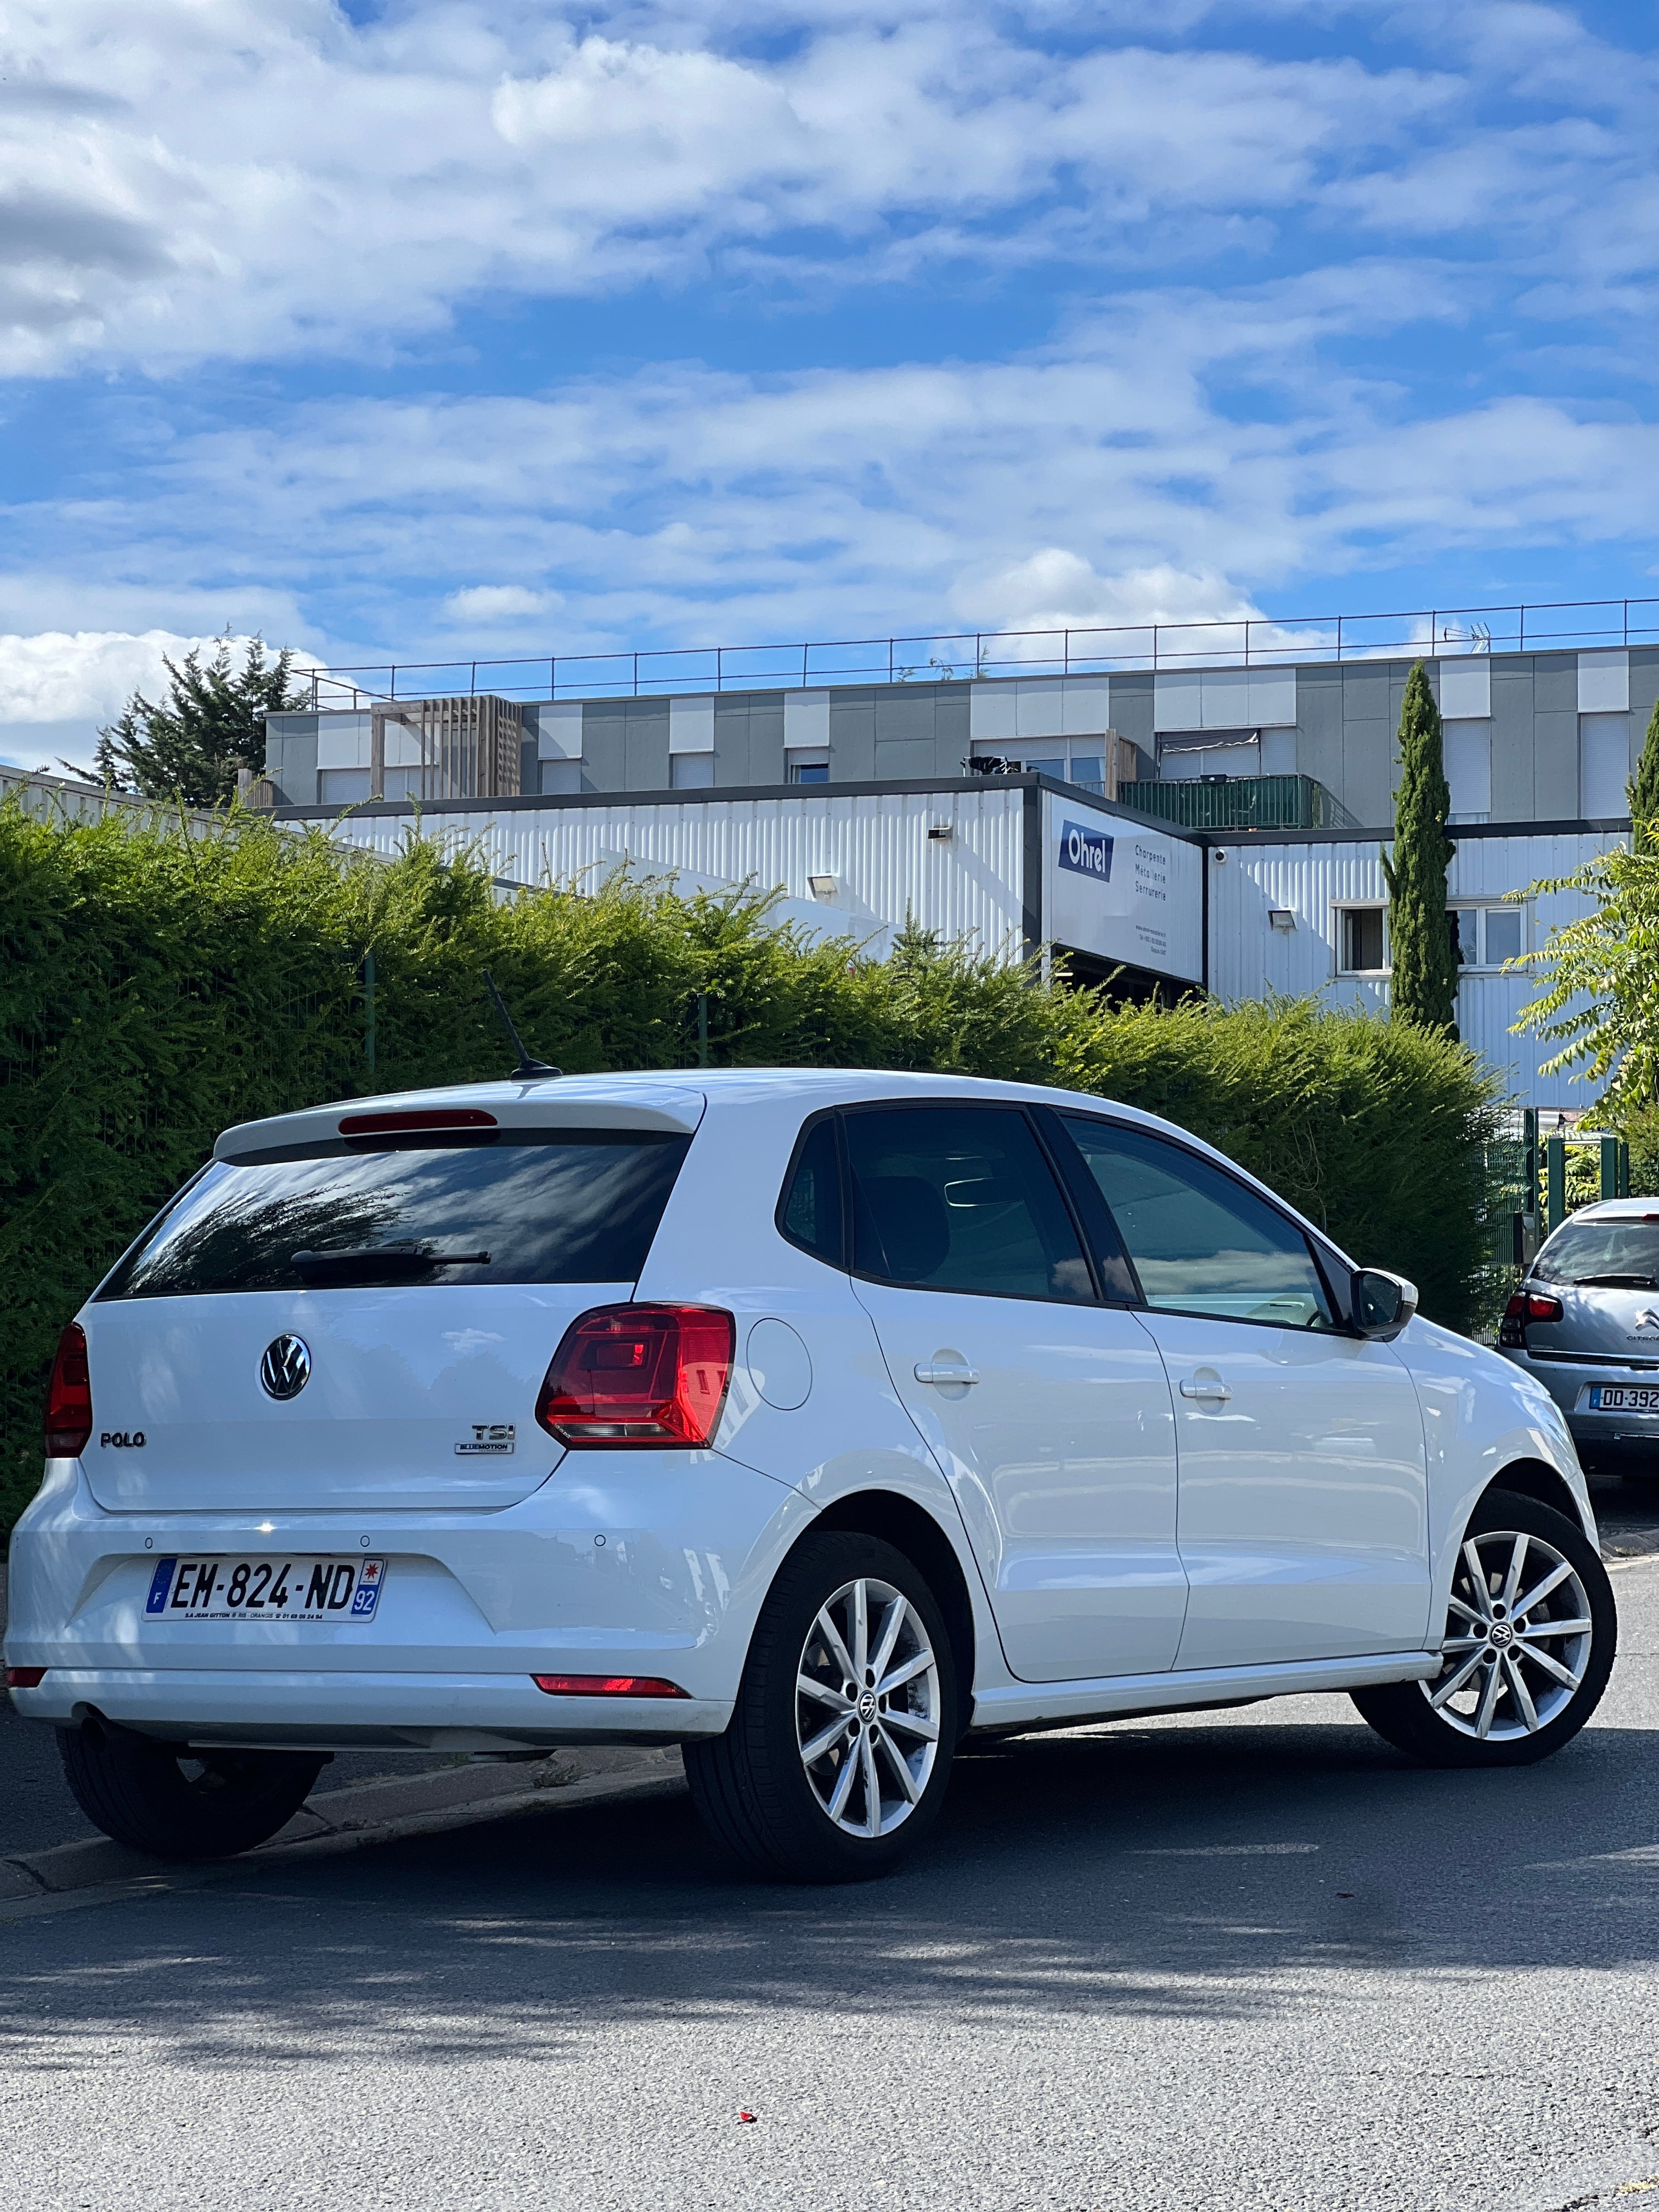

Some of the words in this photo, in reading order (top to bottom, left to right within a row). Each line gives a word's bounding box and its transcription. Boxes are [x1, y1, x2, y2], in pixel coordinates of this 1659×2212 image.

[1068, 828, 1105, 873] Ohrel
[1135, 844, 1166, 865] Charpente
[1135, 863, 1166, 884] Métallerie
[1135, 881, 1166, 901] Serrurerie
[100, 1431, 147, 1448] POLO
[472, 1424, 515, 1440] TSI
[171, 1563, 355, 1610] EM-824-ND
[153, 1592, 162, 1605] F
[354, 1590, 375, 1611] 92
